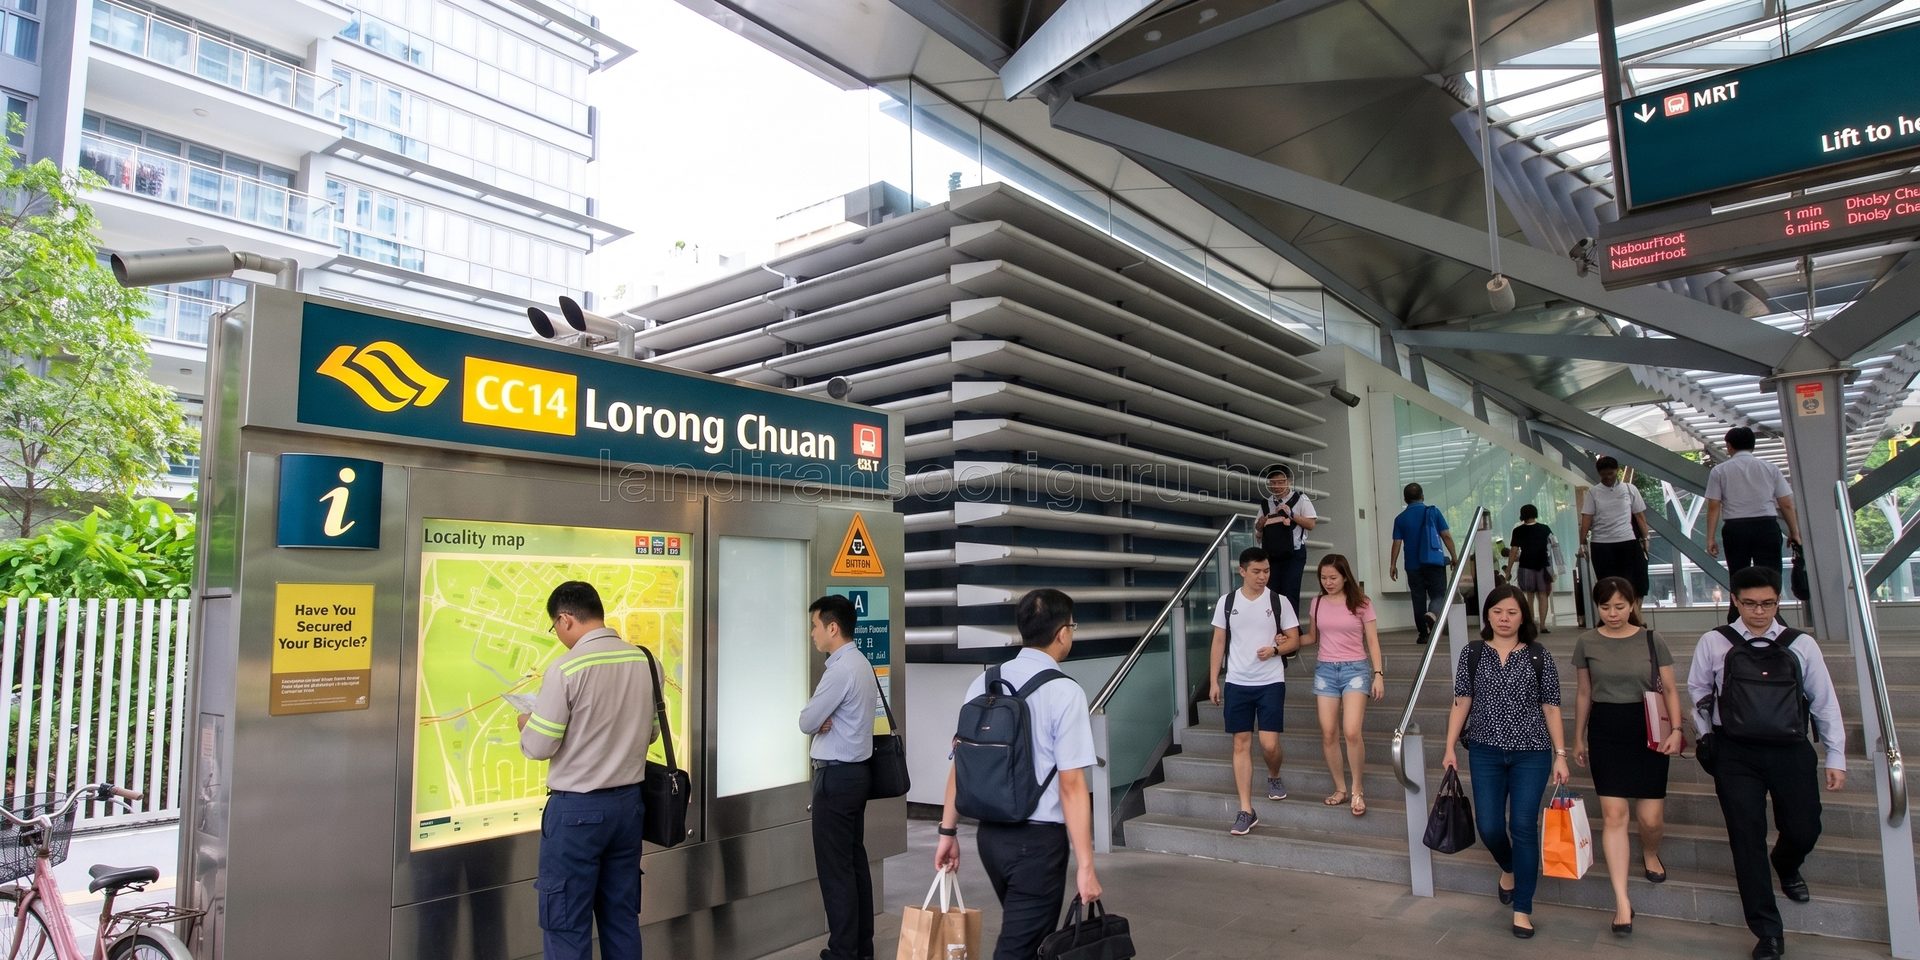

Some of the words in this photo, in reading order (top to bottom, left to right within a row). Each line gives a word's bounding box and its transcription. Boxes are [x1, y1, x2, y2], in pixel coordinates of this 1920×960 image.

[1693, 81, 1739, 108] MRT
[1821, 128, 1861, 152] Lift
[1865, 124, 1891, 142] to
[1784, 210, 1791, 221] 1
[1796, 206, 1822, 219] min
[1785, 224, 1795, 236] 6
[1798, 220, 1830, 234] mins
[475, 375, 568, 419] CC14
[586, 388, 725, 453] Lorong
[737, 414, 835, 461] Chuan
[424, 528, 486, 549] Locality
[492, 534, 525, 550] map
[295, 604, 329, 616] Have
[333, 604, 356, 616] You
[854, 594, 865, 613] A
[296, 620, 352, 632] Secured
[278, 638, 309, 649] Your
[313, 636, 367, 650] Bicycle?
